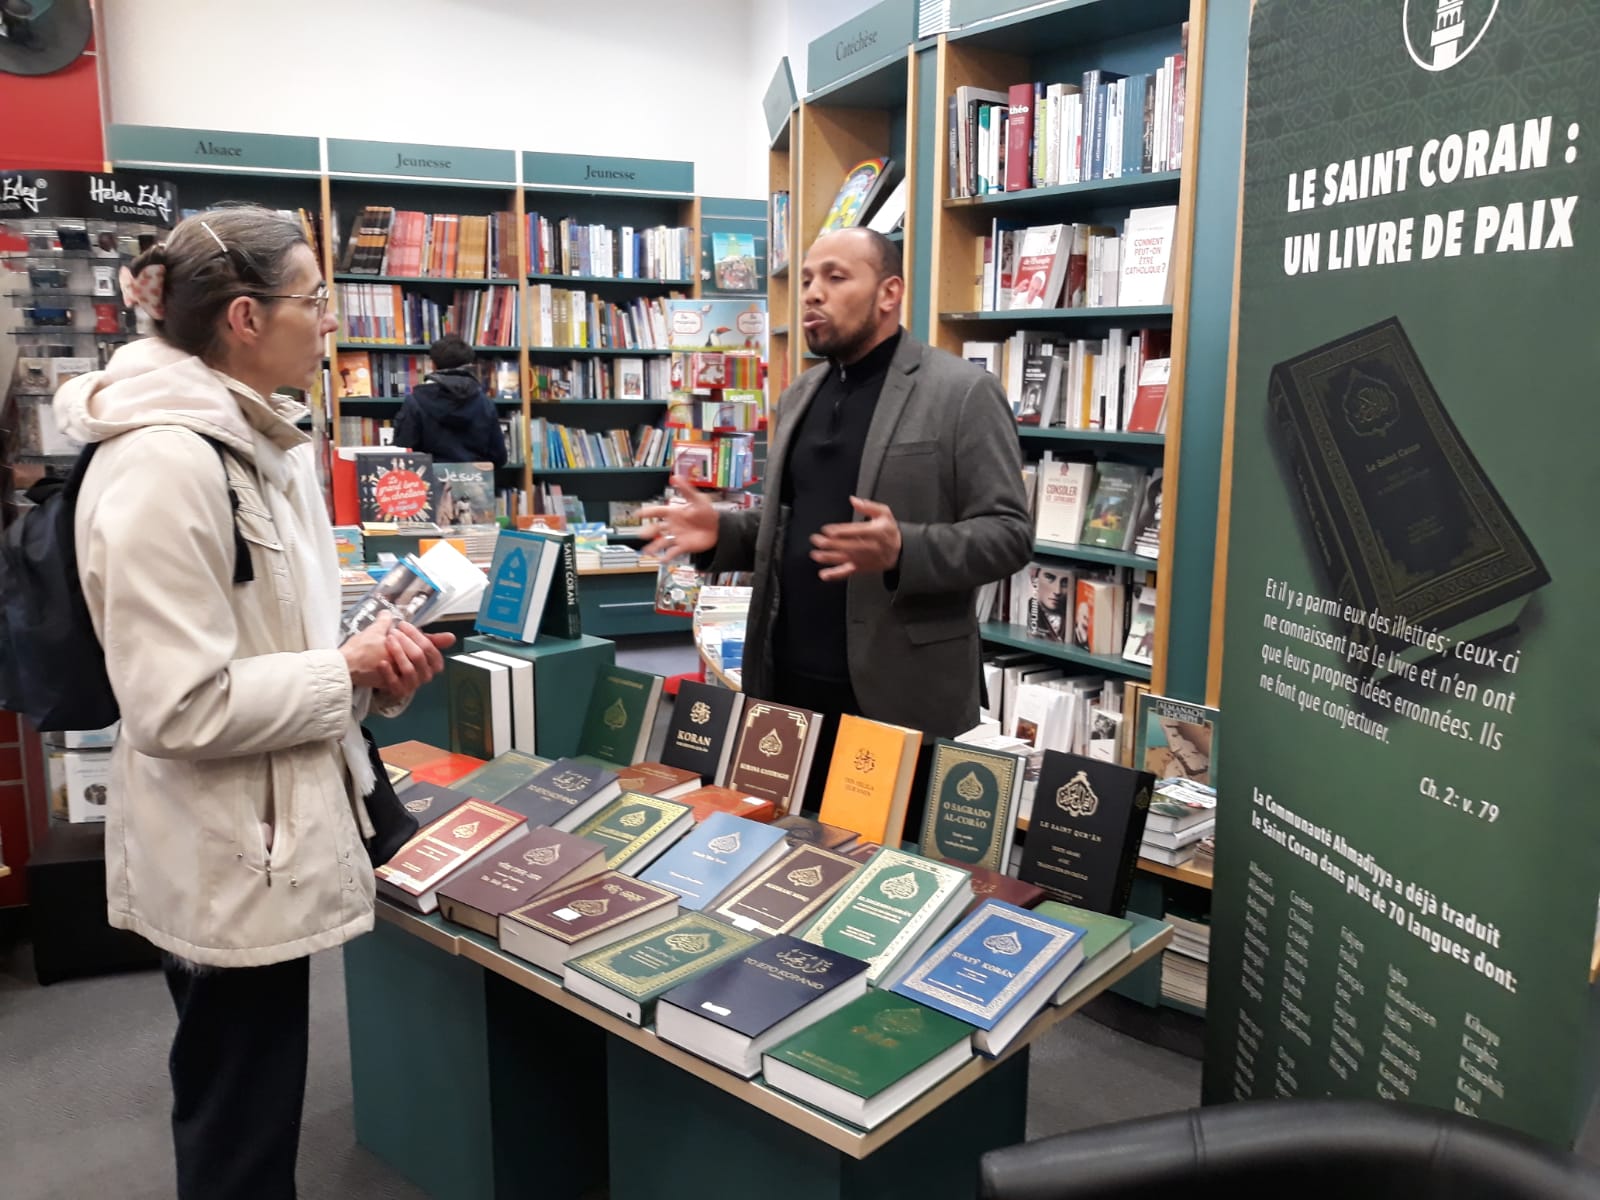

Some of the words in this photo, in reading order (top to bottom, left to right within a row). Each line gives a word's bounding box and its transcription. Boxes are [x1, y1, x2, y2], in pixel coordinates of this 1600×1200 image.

[1009, 104, 1029, 115] théo
[195, 140, 242, 157] Alsace
[395, 153, 452, 169] Jeunesse
[584, 164, 636, 181] Jeunesse
[1287, 168, 1317, 213] LE
[1322, 145, 1413, 207] SAINT
[1419, 115, 1552, 188] CORAN
[1565, 122, 1579, 164] :
[89, 175, 133, 204] Helen
[113, 204, 157, 217] LONDON
[1134, 237, 1164, 247] COMMENT
[1284, 232, 1320, 276] UN
[1328, 217, 1415, 271] LIVRE
[1421, 209, 1465, 260] DE
[1473, 195, 1579, 255] PAIX
[1134, 247, 1161, 256] PEUT-ON
[1046, 484, 1077, 496] CONSOLER
[563, 542, 574, 569] SAINT
[565, 570, 576, 606] CORAN
[1265, 577, 1277, 600] Et
[1277, 581, 1287, 601] il
[1286, 590, 1295, 610] y
[1296, 591, 1303, 607] a
[1304, 593, 1343, 616] parmi
[1344, 603, 1368, 625] eux
[1368, 607, 1390, 634] des
[1454, 640, 1521, 674] ceux-ci
[1263, 612, 1277, 630] ne
[1279, 617, 1347, 655] connaissent
[1347, 638, 1369, 663] pas
[1372, 644, 1386, 669] Le
[1387, 650, 1419, 682] Livre
[1420, 668, 1438, 689] et
[1439, 673, 1478, 702] n'en
[1482, 688, 1517, 715] ont
[1259, 672, 1274, 691] ne
[1275, 673, 1297, 703] font
[1297, 689, 1321, 714] que
[1322, 698, 1390, 745] conjecturer.
[1261, 643, 1282, 665] que
[1283, 646, 1310, 675] leurs
[1312, 663, 1358, 694] propres
[1360, 676, 1393, 709] idées
[1479, 721, 1504, 751] Ils
[677, 730, 711, 747] KORAN
[943, 801, 950, 810] O
[1419, 776, 1440, 801] Ch.
[1442, 786, 1460, 807] 2:
[1461, 796, 1475, 816] v.
[1478, 800, 1500, 823] 79
[1039, 820, 1049, 828] LE
[1050, 823, 1073, 834] SAINT
[1253, 786, 1265, 805] La
[1265, 794, 1332, 847] Communauté
[1333, 834, 1393, 890] Ahmadiyya
[1395, 877, 1403, 895] a
[1405, 880, 1437, 916] déjà
[1440, 901, 1502, 949] traduit
[1252, 809, 1262, 830] le
[1262, 818, 1287, 848] Saint
[1287, 834, 1319, 867] Coran
[1319, 853, 1346, 884] dans
[1346, 874, 1371, 904] plus
[1372, 890, 1387, 915] de
[1388, 900, 1406, 927] 70
[1407, 912, 1471, 966] langues
[1473, 952, 1518, 995] dont:
